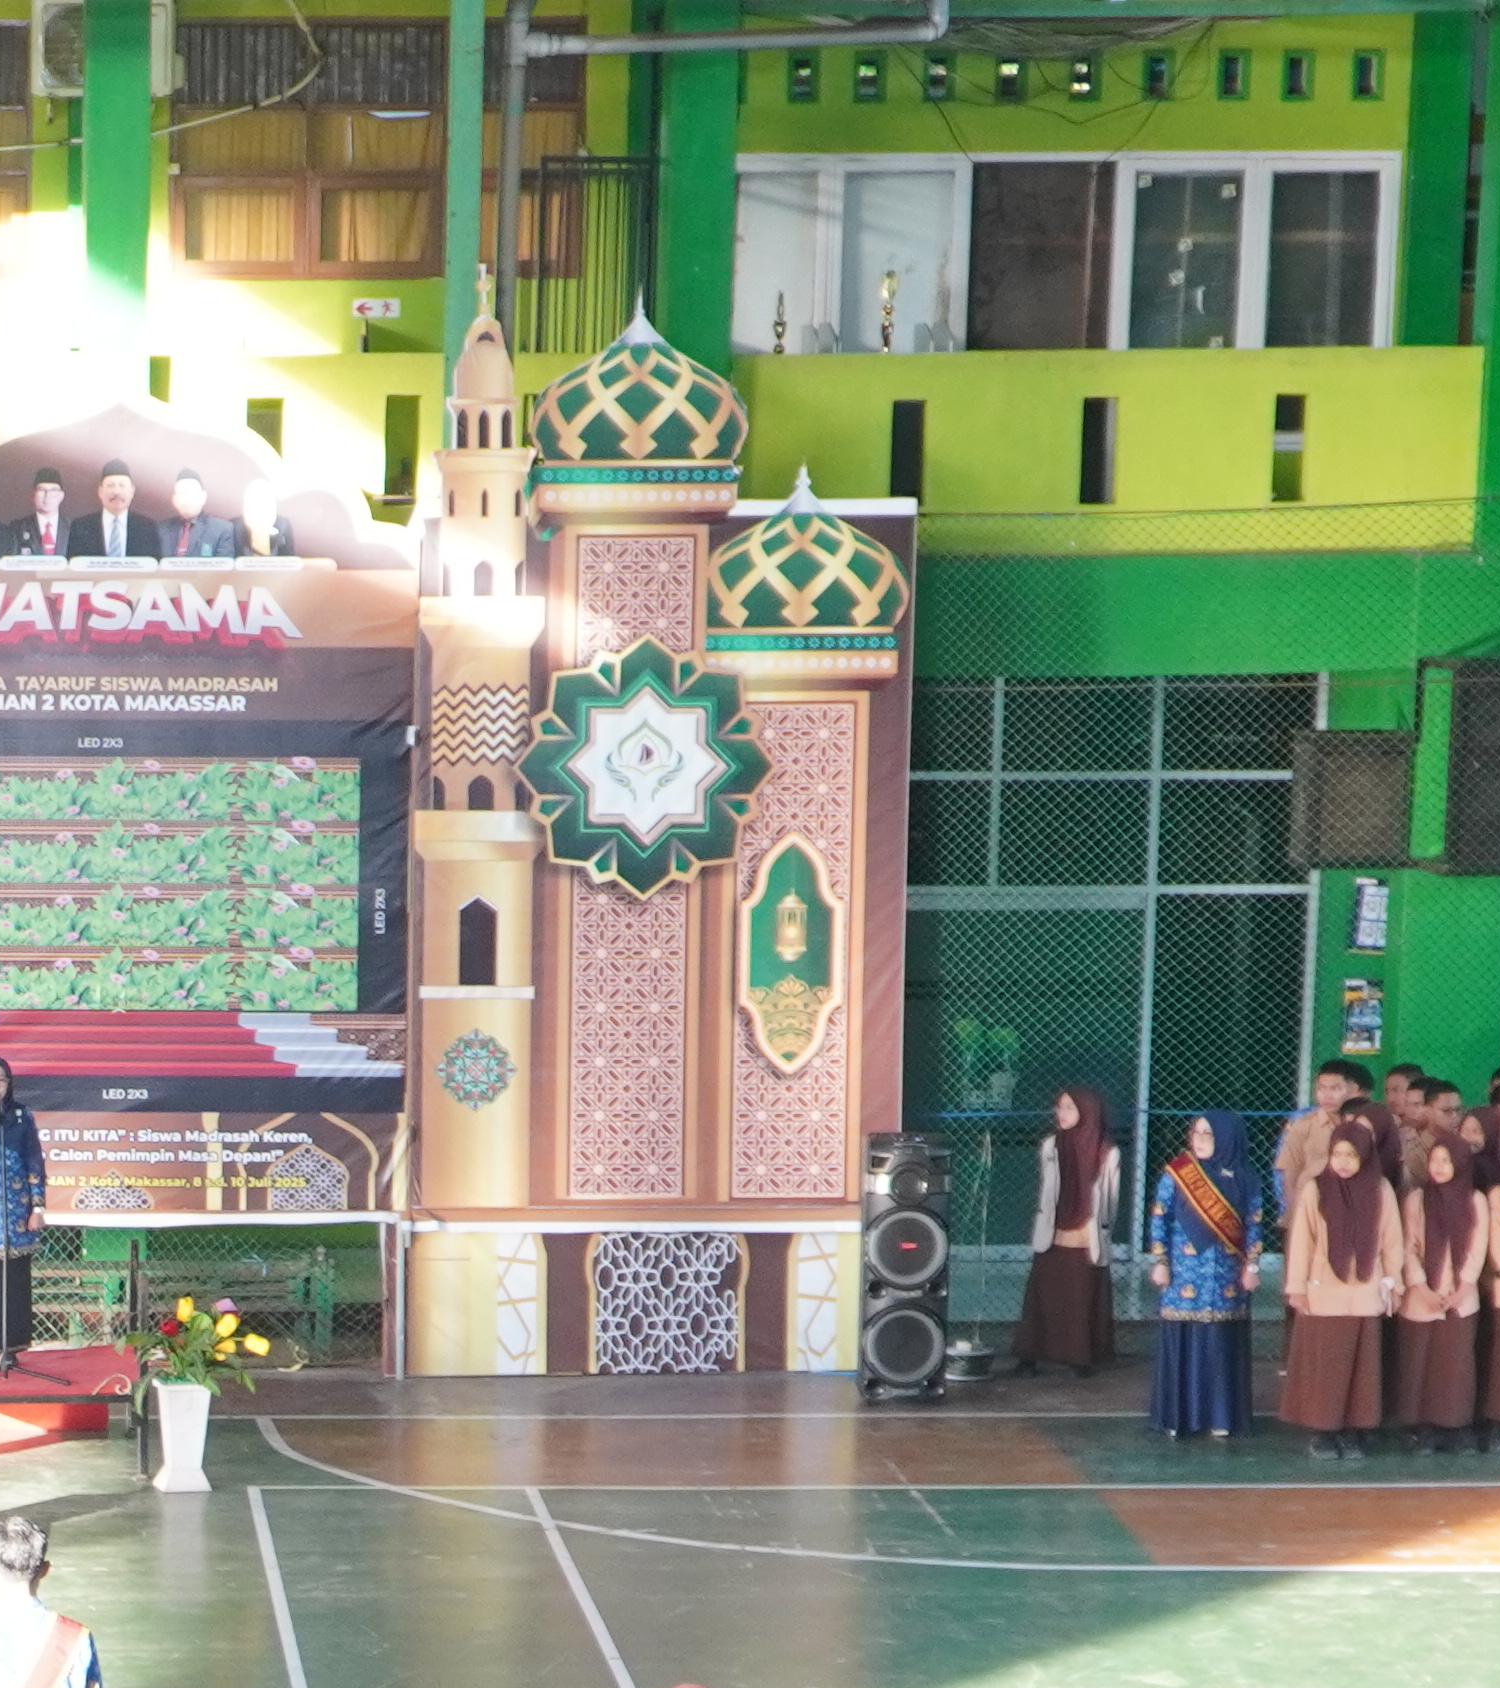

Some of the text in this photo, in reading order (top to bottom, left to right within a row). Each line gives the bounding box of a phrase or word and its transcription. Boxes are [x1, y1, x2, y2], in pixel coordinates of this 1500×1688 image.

[16, 675, 97, 691] TA'ARUF
[100, 675, 163, 692] SISWA
[167, 676, 279, 692] MADRASAH
[41, 693, 55, 711] 2
[60, 694, 121, 711] KOTA
[124, 694, 247, 712] MAKASSAR
[77, 737, 101, 749] LED
[374, 910, 386, 935] LED
[102, 1088, 149, 1100] LED 2X3
[54, 1128, 80, 1142] ITU
[137, 1128, 182, 1143] Siswa
[185, 1128, 260, 1144] Madrasah
[263, 1129, 314, 1144] Keren,
[48, 1148, 94, 1162] Calon
[97, 1148, 175, 1164] Pemimpin
[179, 1149, 218, 1162] Masa
[78, 1176, 87, 1186] 2
[89, 1175, 121, 1187] Kota
[124, 1175, 191, 1188] Makassar,
[193, 1176, 202, 1187] 8
[231, 1176, 244, 1187] 10
[246, 1175, 272, 1187] Juli
[275, 1176, 307, 1188] 2025
